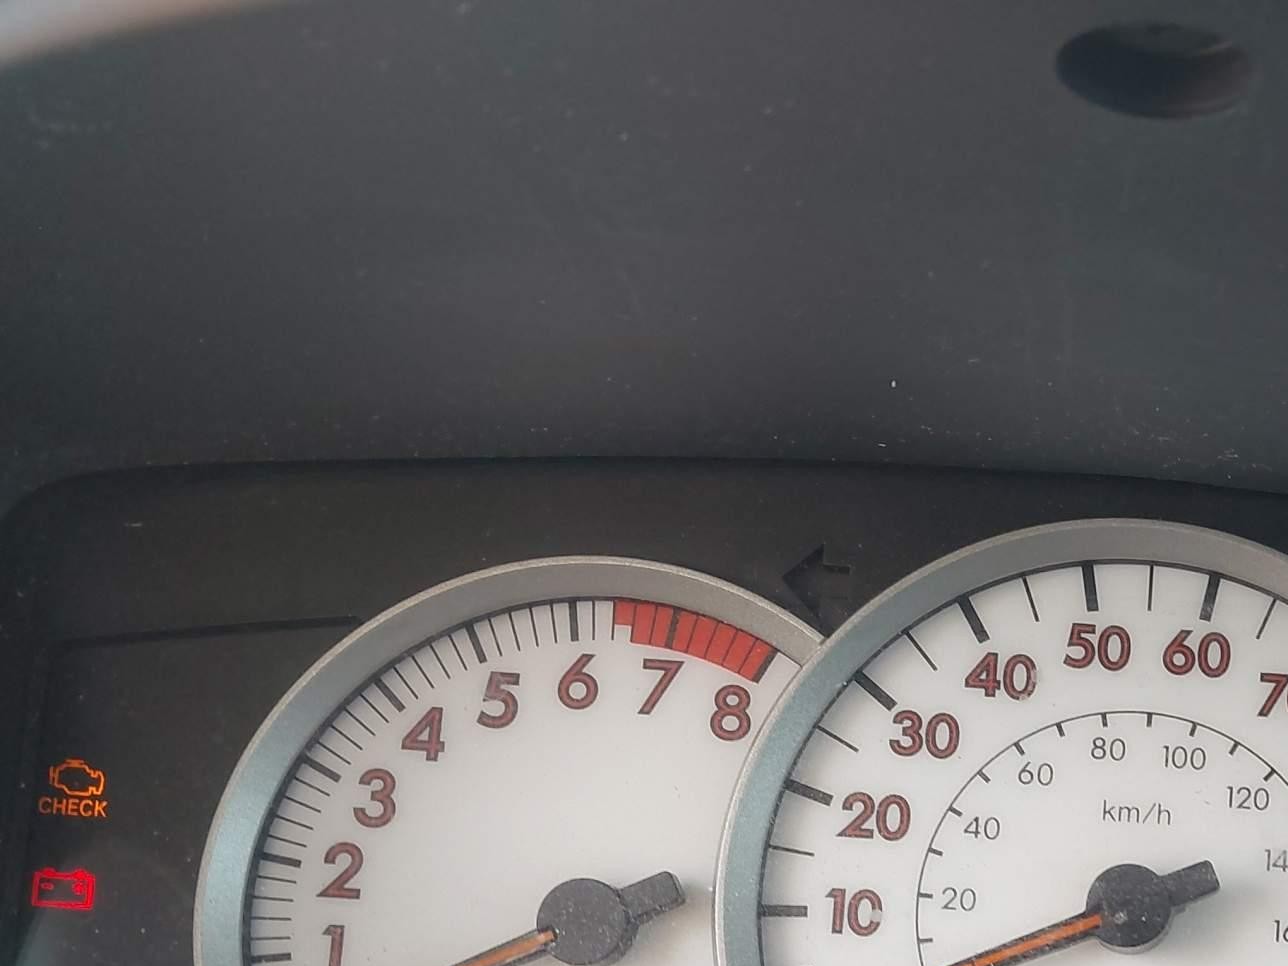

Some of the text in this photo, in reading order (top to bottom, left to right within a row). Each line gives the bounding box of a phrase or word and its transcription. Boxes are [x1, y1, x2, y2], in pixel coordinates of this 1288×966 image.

[1063, 623, 1131, 671] 50
[1163, 629, 1231, 678] 60
[477, 671, 520, 729] 5
[558, 653, 598, 710] 6
[637, 658, 685, 715] 7
[965, 652, 1037, 701] 40
[401, 707, 445, 762] 4
[710, 684, 751, 741] 8
[889, 710, 960, 759] 30
[1018, 761, 1053, 786] 60
[1091, 737, 1125, 761] 80
[1163, 745, 1206, 770] 100
[38, 798, 108, 817] CHECK
[353, 768, 396, 828] 3
[836, 792, 911, 841] 20
[1103, 800, 1171, 825] km/h
[1227, 786, 1269, 811] 120
[964, 816, 1000, 840] 40
[316, 842, 363, 899] 2
[825, 888, 882, 937] 10
[942, 887, 976, 911] 20
